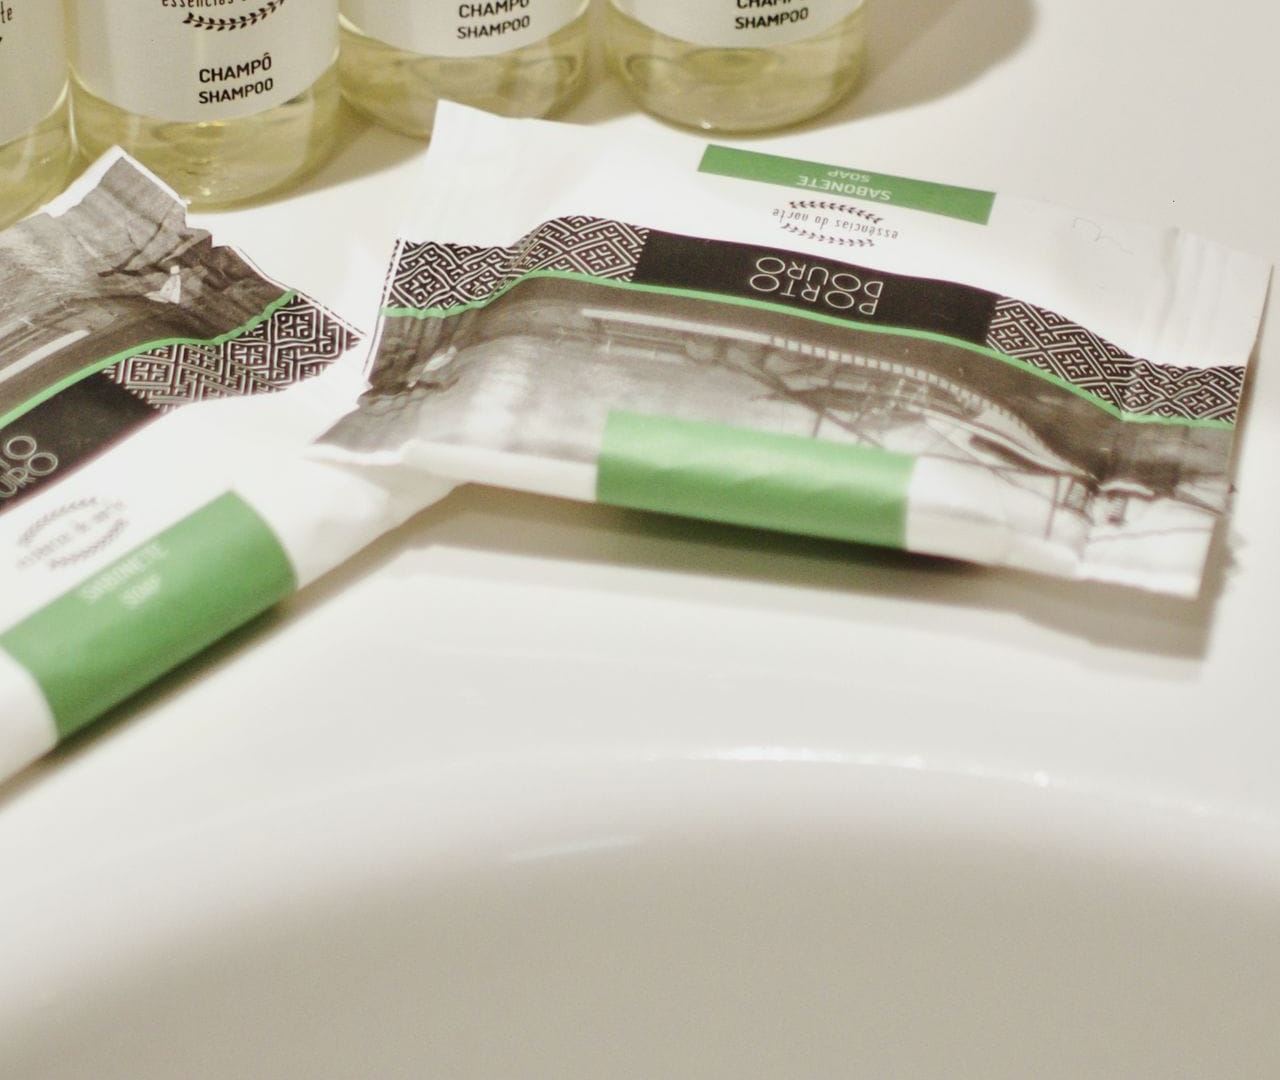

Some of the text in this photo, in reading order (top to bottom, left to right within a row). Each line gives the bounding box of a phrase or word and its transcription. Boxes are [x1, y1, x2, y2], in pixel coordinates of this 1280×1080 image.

[457, 16, 530, 39] SHAMPOO
[735, 7, 808, 30] SHAMPOO
[199, 52, 272, 84] CHAMPÔ
[198, 78, 274, 104] SHAMPOO
[827, 169, 870, 182] SOAP
[796, 176, 892, 201] SABONETE
[773, 208, 808, 222] norte
[815, 214, 828, 229] do
[755, 257, 884, 298] DOURO
[750, 273, 879, 315] PORTO
